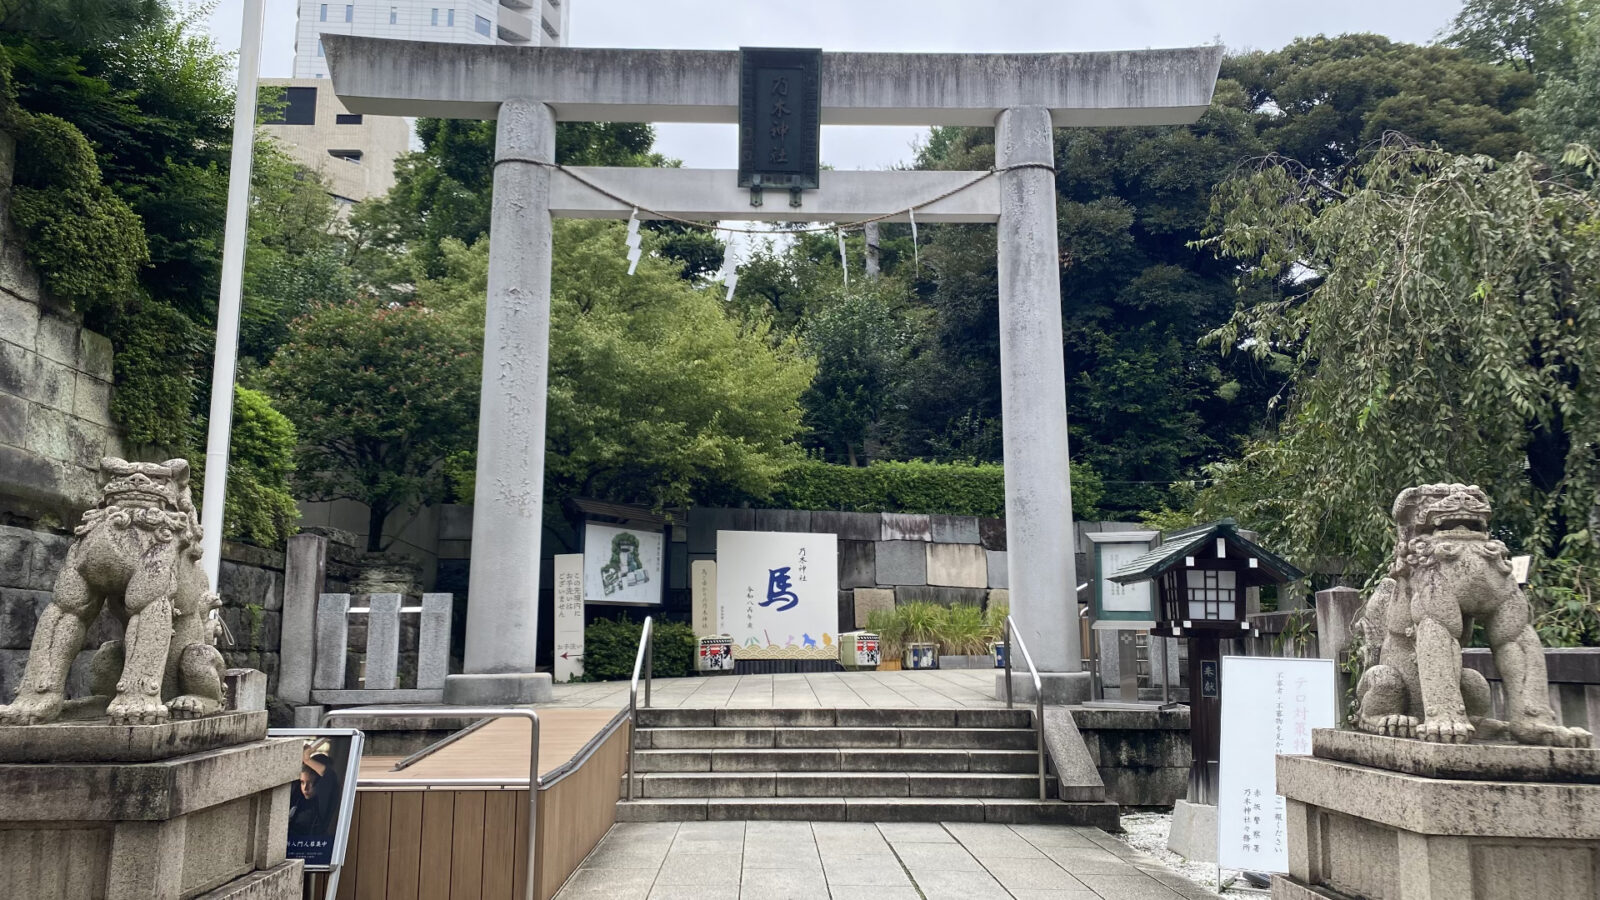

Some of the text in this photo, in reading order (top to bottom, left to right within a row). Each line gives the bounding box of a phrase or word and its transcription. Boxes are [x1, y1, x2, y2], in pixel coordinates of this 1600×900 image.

[770, 77, 791, 164] 乃木神社
[798, 547, 807, 581] 乃木神社
[558, 572, 566, 618] ございません
[566, 573, 574, 610] お手洗いは
[758, 566, 799, 612] 馬
[1253, 788, 1261, 853] 赤坂警察署
